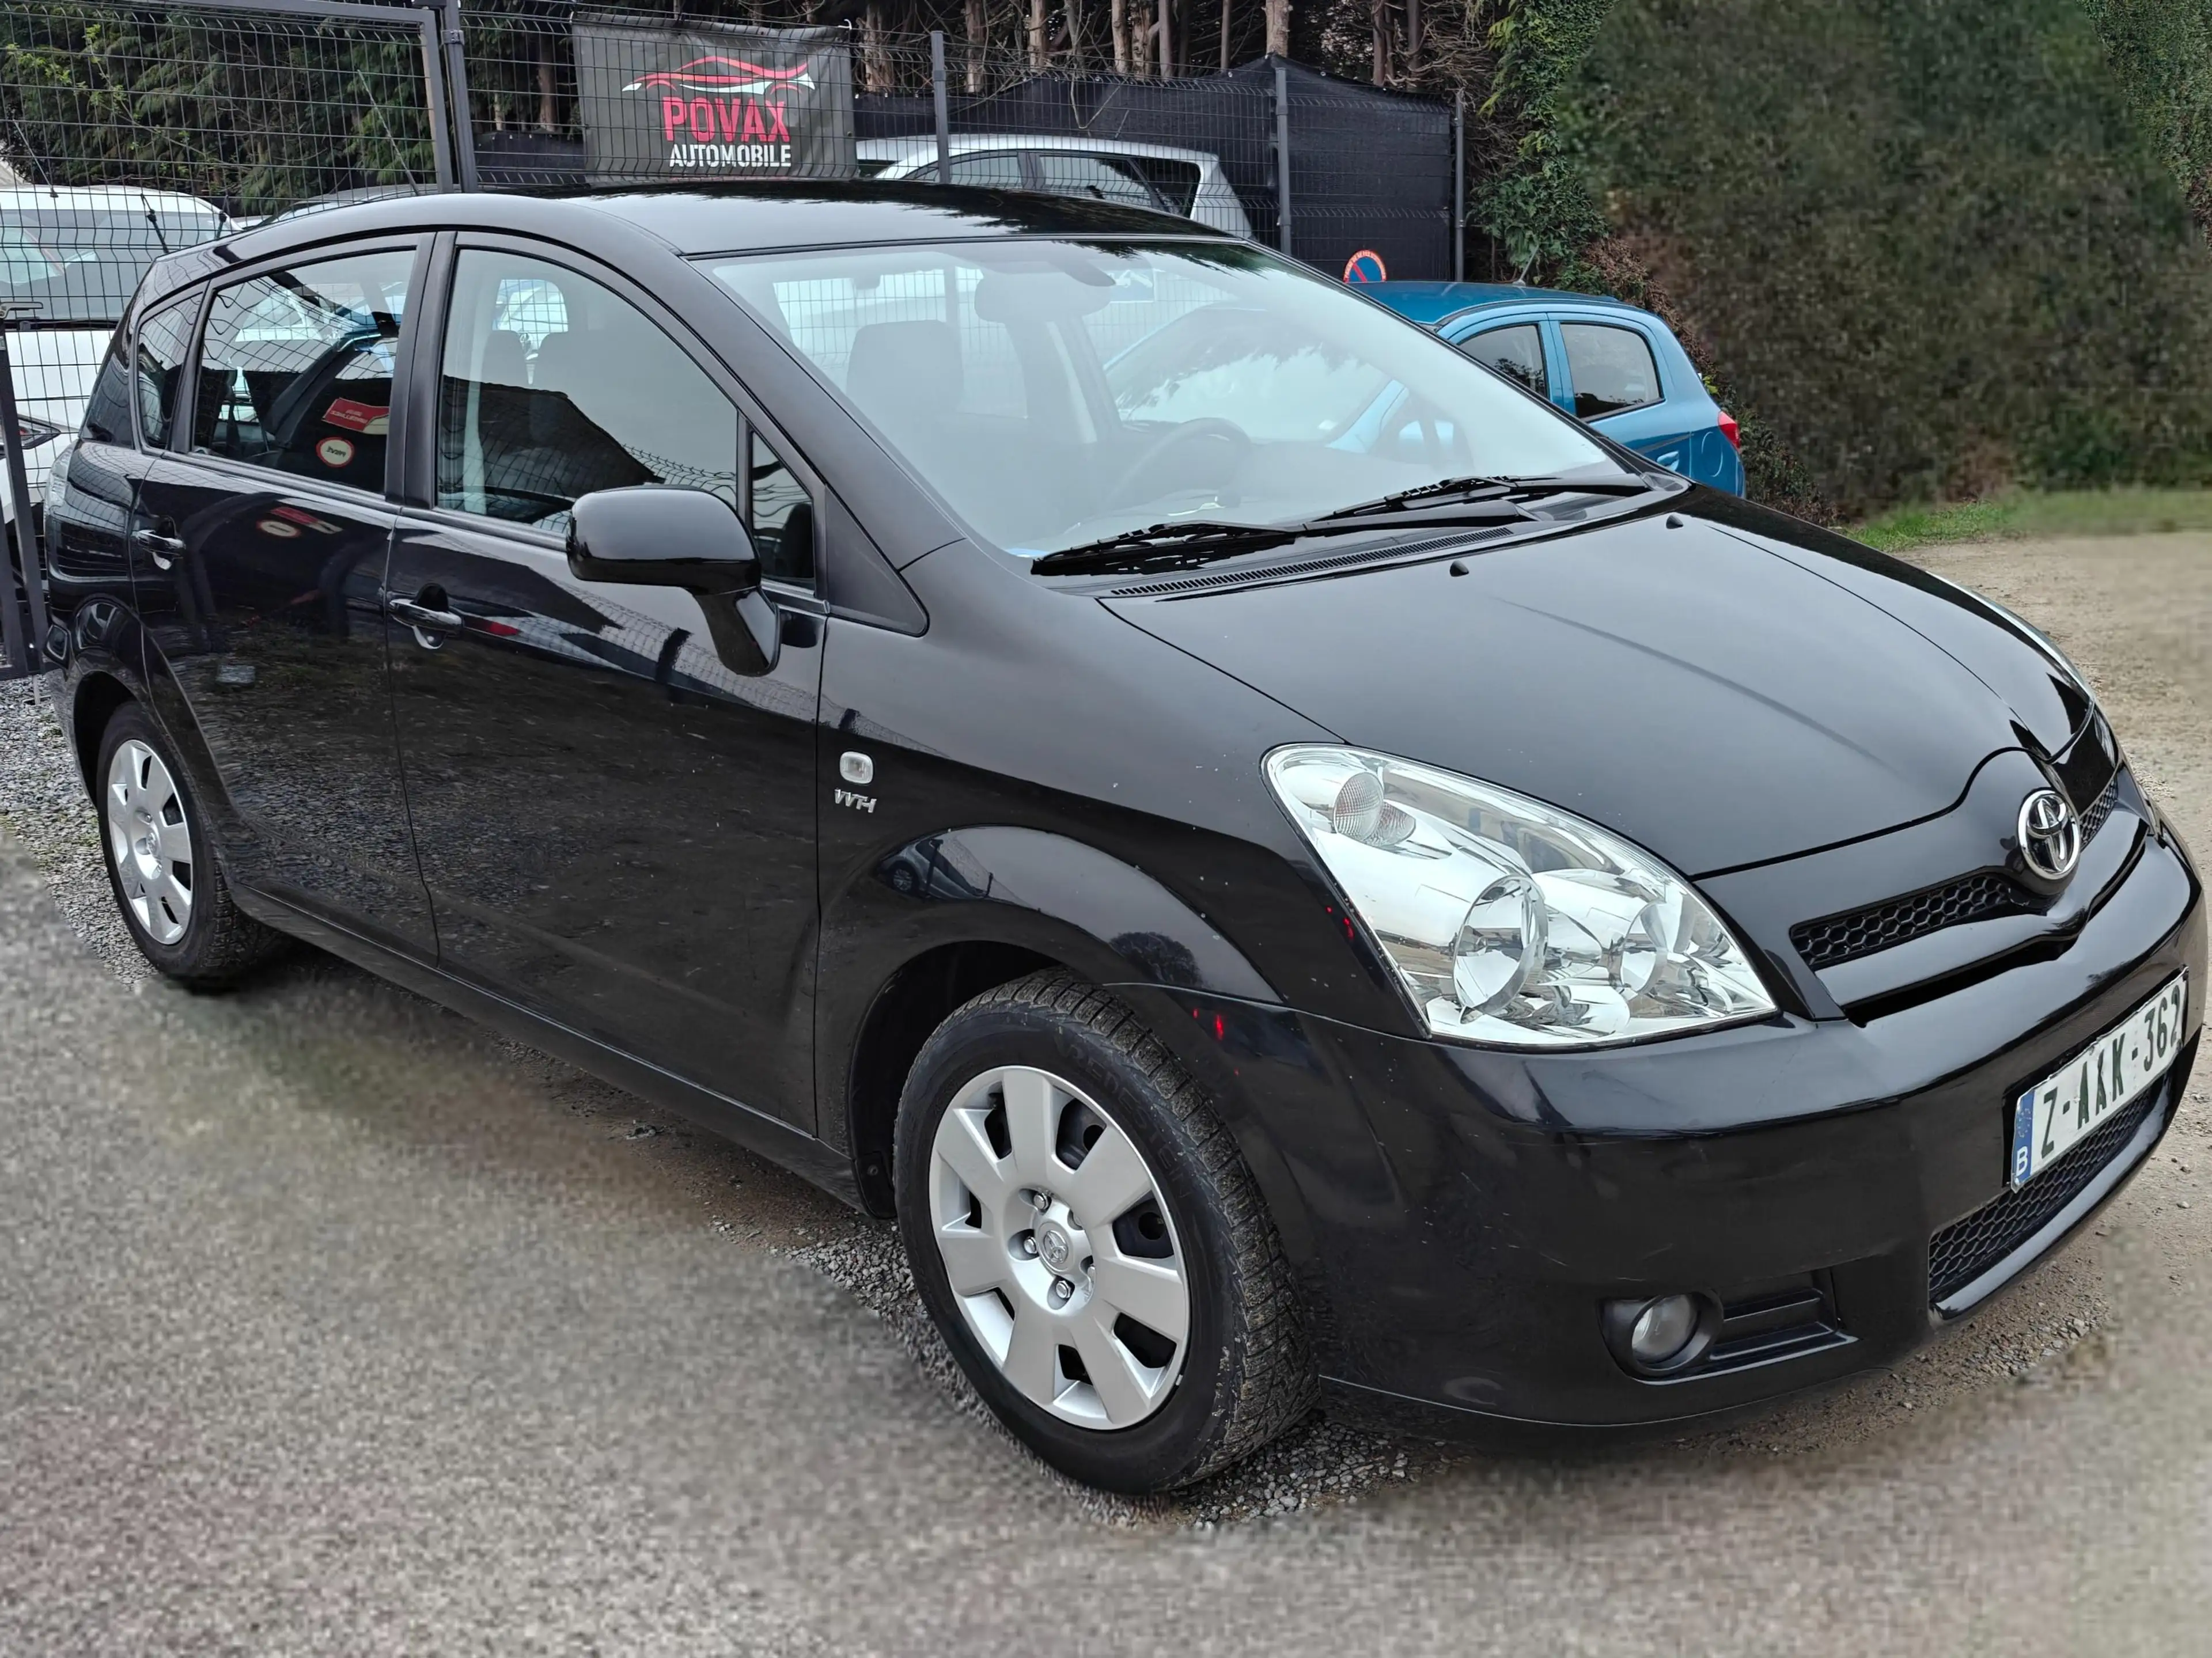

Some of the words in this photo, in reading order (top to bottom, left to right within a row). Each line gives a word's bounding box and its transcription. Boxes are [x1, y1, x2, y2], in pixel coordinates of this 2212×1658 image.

[663, 97, 790, 142] POVAX
[669, 144, 791, 167] AUTOMOBILE
[2041, 984, 2180, 1159] Z-AAK-362
[2016, 1145, 2028, 1176] B
